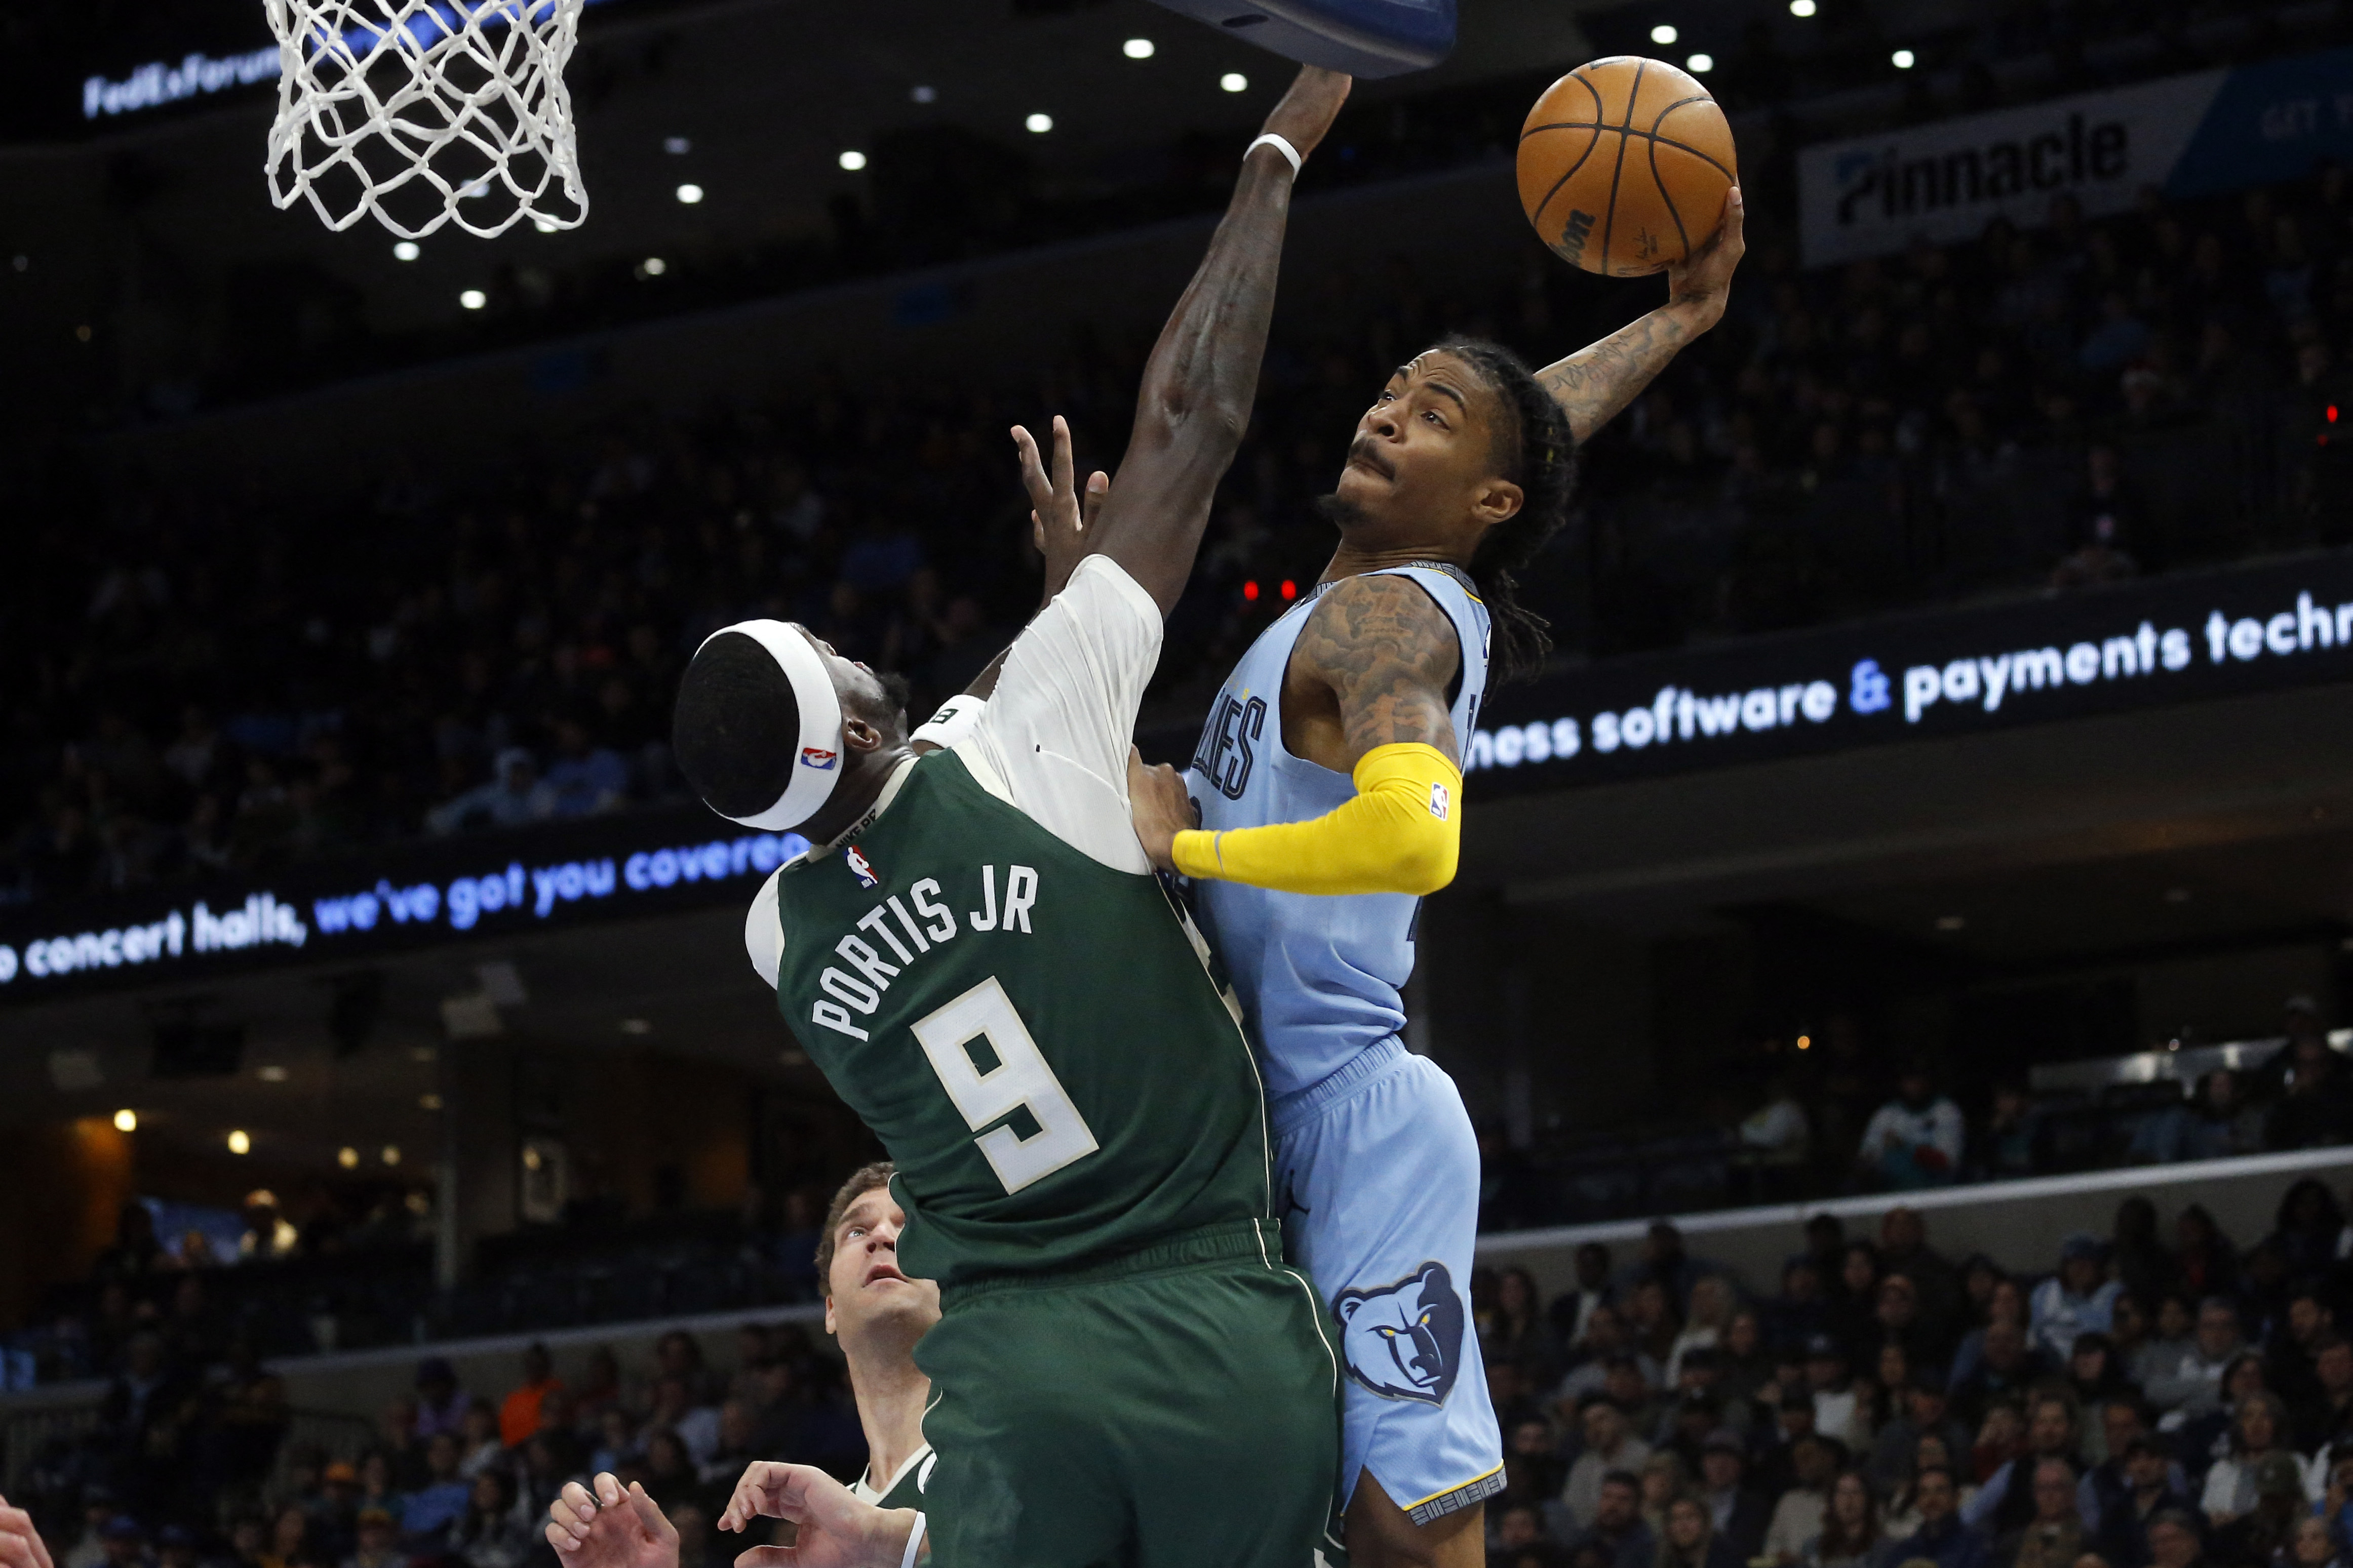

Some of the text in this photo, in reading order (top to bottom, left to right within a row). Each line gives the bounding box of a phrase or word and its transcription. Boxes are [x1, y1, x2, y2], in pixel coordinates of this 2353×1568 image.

[1837, 111, 2125, 224] Pinnacle
[1592, 681, 1837, 752] software
[1849, 658, 1892, 714] &
[1904, 621, 2191, 723] payments
[24, 911, 186, 978] concert
[192, 892, 307, 952] halls,
[313, 879, 440, 935] we've
[447, 862, 526, 931] got
[531, 859, 617, 918] you
[812, 864, 1039, 1042] PORTIS JR
[910, 975, 1101, 1196] 9
